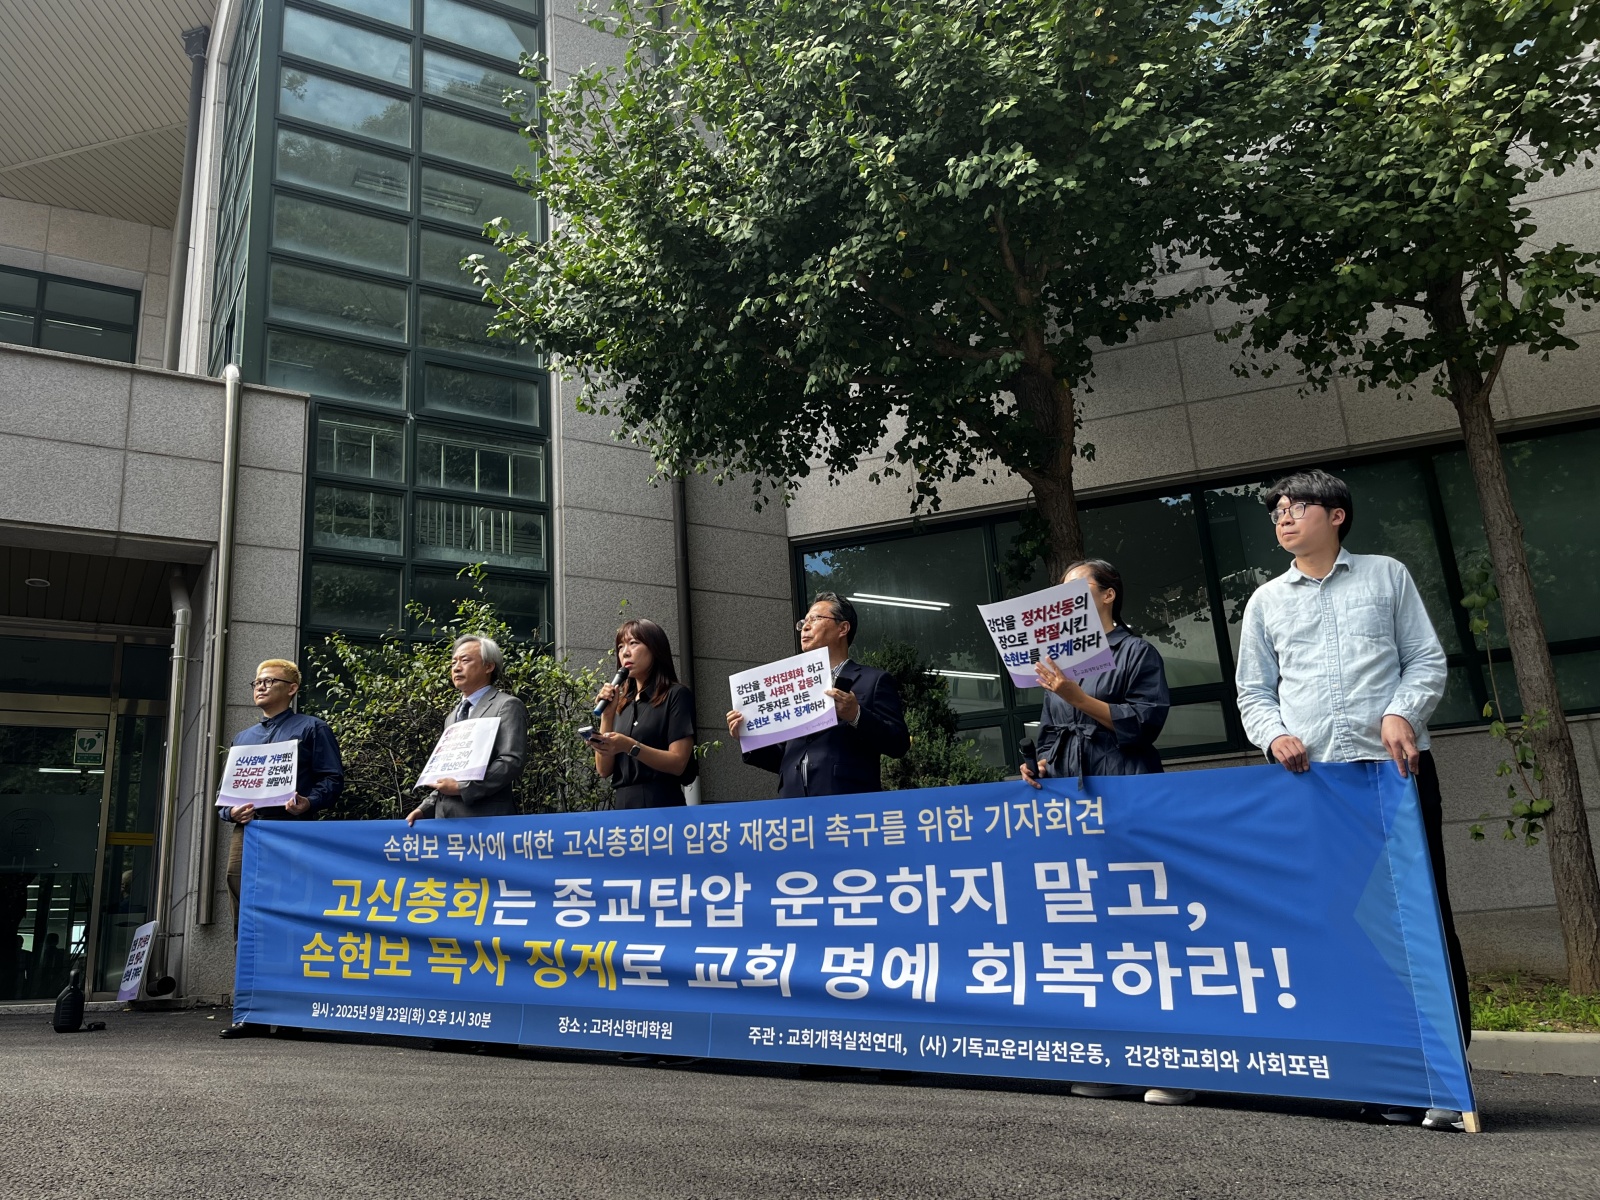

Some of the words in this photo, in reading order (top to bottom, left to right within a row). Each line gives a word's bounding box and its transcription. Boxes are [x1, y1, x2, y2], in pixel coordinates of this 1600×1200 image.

[987, 614, 1016, 633] 강단을
[1021, 593, 1088, 627] 정치선동의
[998, 632, 1029, 650] 장으로
[1034, 614, 1088, 644] 변절시킨
[1003, 648, 1041, 667] 손현보를
[1047, 631, 1102, 661] 징계하라
[736, 680, 760, 696] 강단을
[763, 667, 805, 688] 정치집회화
[807, 661, 824, 674] 하고
[742, 691, 766, 706] 교회를
[770, 683, 795, 698] 사회적
[797, 674, 822, 689] 갈등의
[746, 716, 771, 731] 손현보
[773, 709, 791, 722] 목사
[794, 699, 826, 717] 징계하라
[758, 697, 791, 714] 주동자로
[794, 691, 811, 704] 만든
[233, 767, 266, 777] 고신교단
[267, 763, 293, 776] 강단에서
[235, 755, 268, 766] 신사참배
[269, 752, 293, 763] 거부했던
[232, 778, 265, 789] 정치선동
[384, 834, 439, 861] 손현보
[447, 832, 505, 861] 목사에
[513, 830, 554, 859] 대한
[563, 824, 672, 857] 고신총회의
[684, 821, 730, 854] 입장
[740, 816, 813, 851] 재정리
[826, 811, 906, 847] 촉구를
[918, 805, 973, 842] 위한
[985, 797, 1104, 838] 기자회견
[323, 878, 536, 925] 고신총회는
[553, 873, 751, 927] 종교탄압
[771, 862, 1007, 926] 운운하지
[1034, 859, 1206, 931] 말고,
[301, 933, 411, 979] 손현보
[428, 937, 508, 986] 목사
[524, 939, 668, 990] 징계로
[688, 943, 796, 996] 교회
[821, 943, 938, 1002] 명예
[966, 942, 1296, 1013] 회복하라!
[312, 1003, 328, 1017] 일시
[335, 1005, 367, 1020] 2025년
[369, 1006, 384, 1021] 9월
[386, 1007, 425, 1025] 23일(화)
[427, 1010, 447, 1025] 오후
[449, 1011, 465, 1026] 1시
[468, 1013, 491, 1028] 30분
[559, 1017, 580, 1033] 장소
[590, 1019, 672, 1039] 고려신학대학원
[749, 1027, 775, 1045] 주관
[787, 1029, 907, 1055] 교회개혁실천연대,
[952, 1037, 1110, 1067] 기독교윤리실천운동,
[1125, 1045, 1239, 1073] 건강한교회와
[1247, 1052, 1329, 1079] 사회포럼
